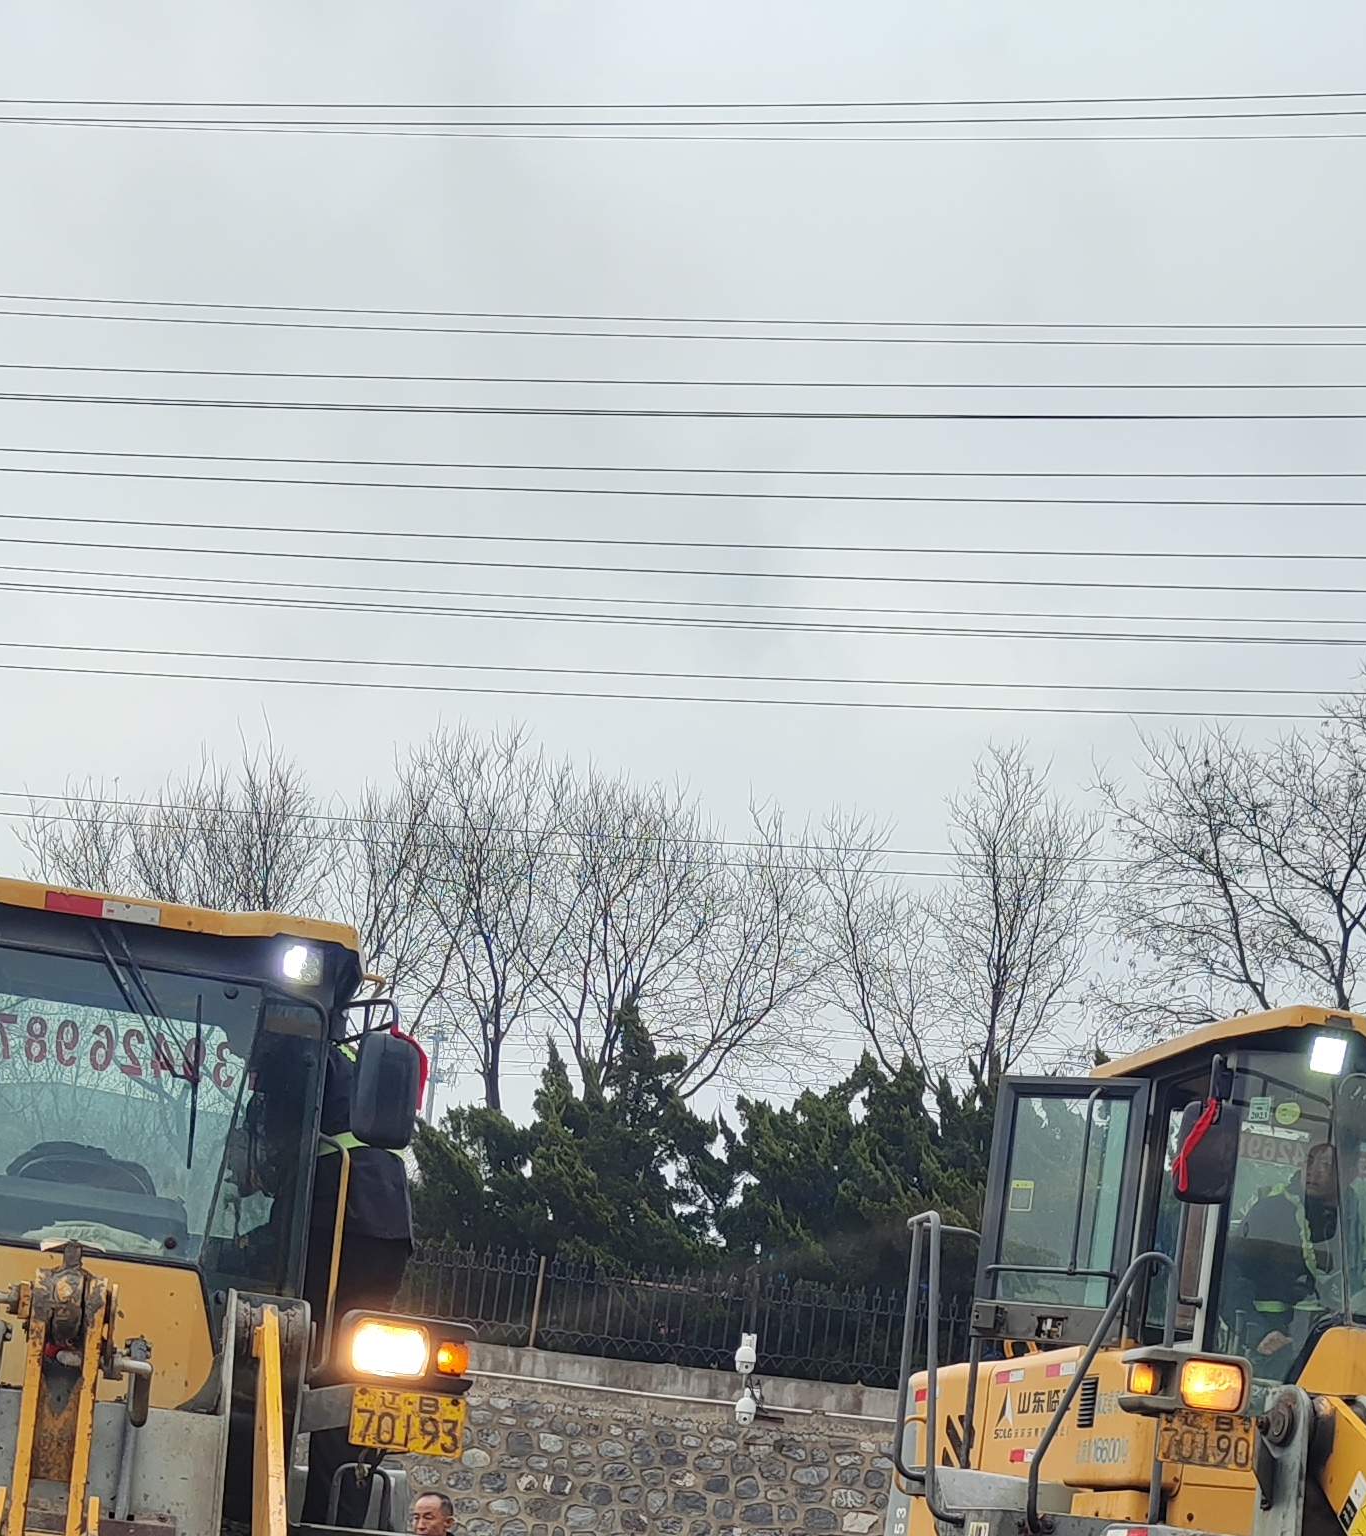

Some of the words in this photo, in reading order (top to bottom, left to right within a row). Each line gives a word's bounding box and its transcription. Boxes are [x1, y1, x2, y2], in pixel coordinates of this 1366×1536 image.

[1017, 1388, 1071, 1415] 山东临
[356, 1408, 460, 1453] 70193
[1161, 1427, 1250, 1467] 70190
